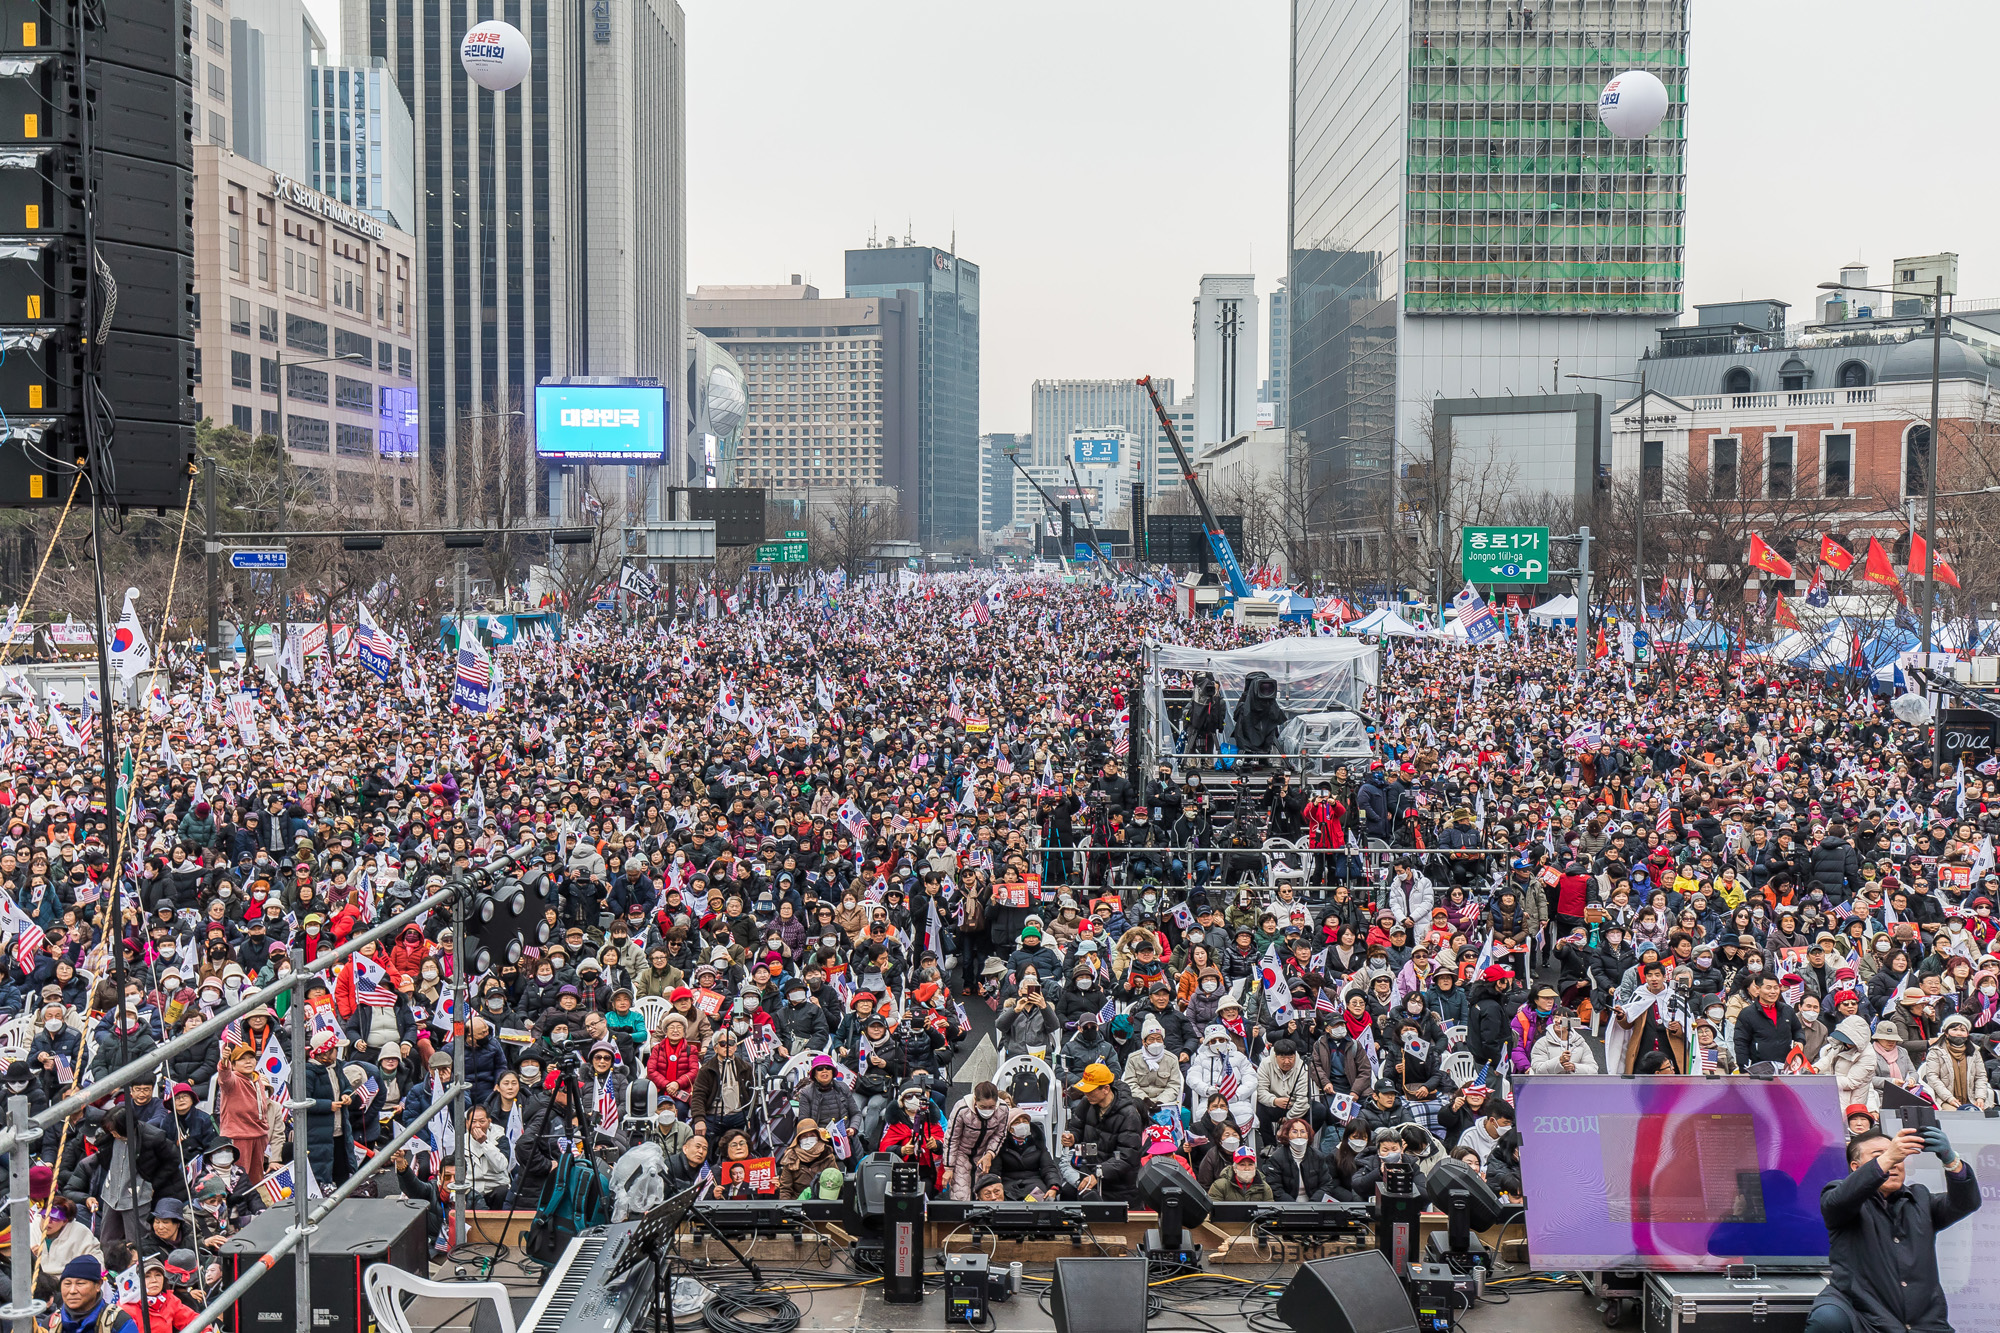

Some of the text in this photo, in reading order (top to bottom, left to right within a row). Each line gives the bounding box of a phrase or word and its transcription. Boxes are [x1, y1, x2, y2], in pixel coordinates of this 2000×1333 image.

[468, 32, 501, 44] 광화문
[464, 45, 505, 59] 국민대회
[293, 183, 322, 213] SEOUL
[322, 197, 358, 229] FINANCE
[358, 214, 386, 240] CENTER
[560, 408, 640, 428] 대한민국
[1081, 442, 1112, 456] 광고
[1469, 532, 1540, 549] 종로1가
[1468, 552, 1523, 563] Jongno 1(il)-ga
[1508, 566, 1515, 575] 6
[1945, 732, 1990, 749] Once
[1010, 897, 1026, 905] 무효
[749, 1168, 771, 1181] 원천
[749, 1180, 770, 1191] 무효
[899, 1226, 909, 1273] Fire Storm
[1396, 1226, 1406, 1273] Fire Storm
